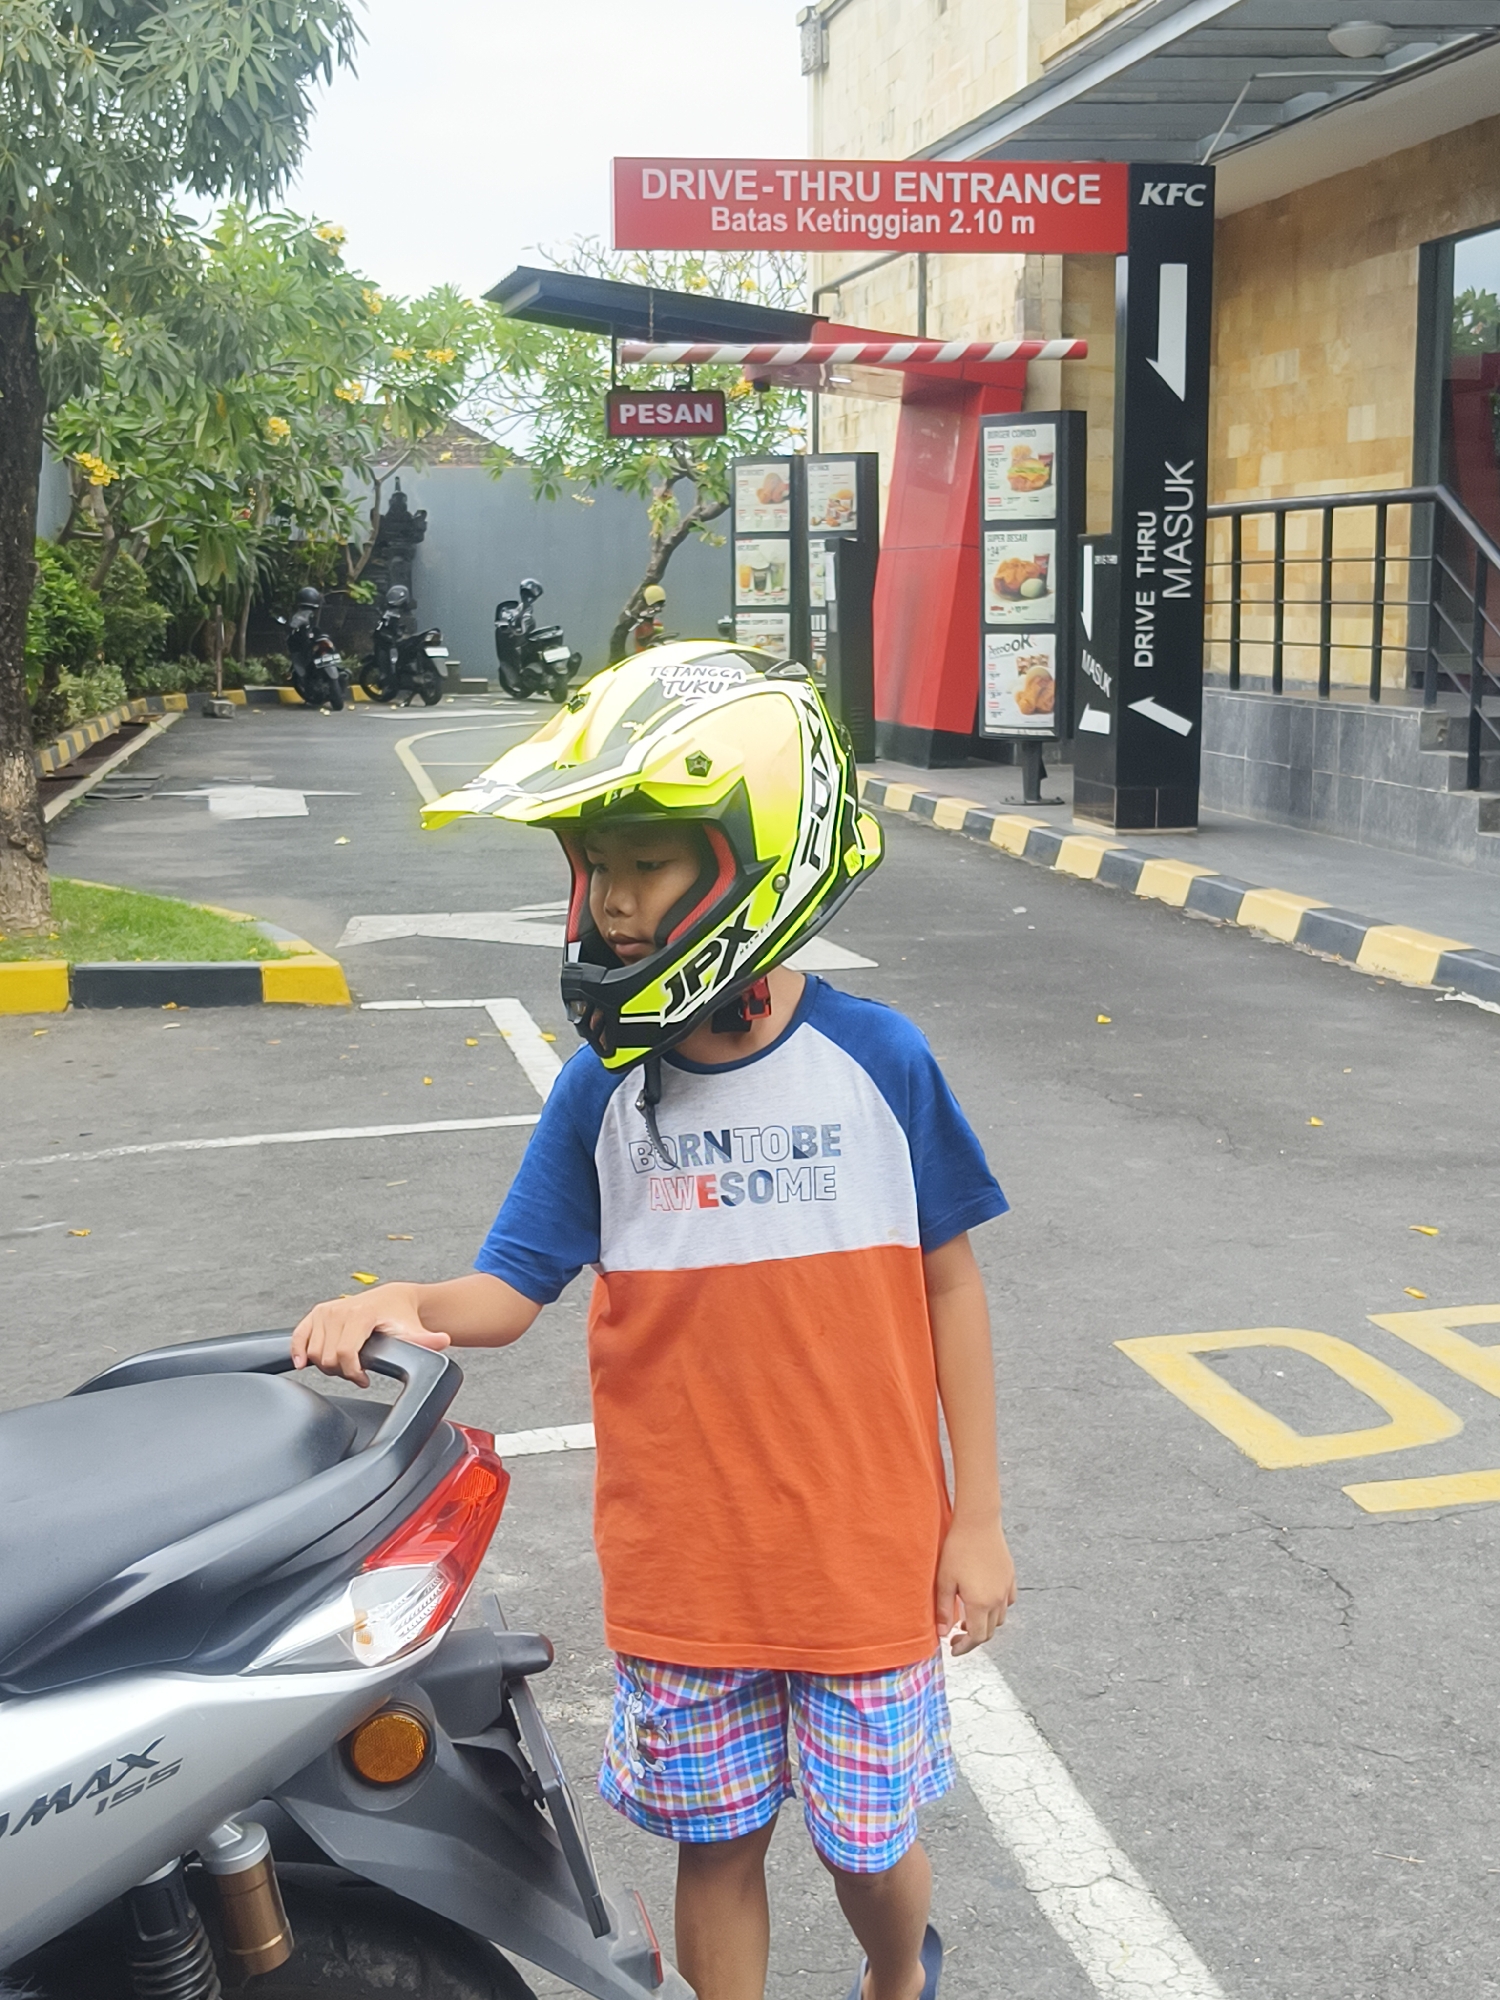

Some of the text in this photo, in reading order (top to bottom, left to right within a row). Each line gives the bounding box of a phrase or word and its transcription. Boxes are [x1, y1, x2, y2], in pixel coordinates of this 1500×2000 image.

[641, 168, 1102, 205] DRIVE-THRU ENTRANCE
[1138, 182, 1207, 207] KFC
[711, 206, 1035, 240] Batas Ketinggian 2.10 m
[620, 403, 714, 424] PESAN
[1161, 459, 1194, 600] MASUK
[1133, 511, 1157, 668] DRIVE THRU
[666, 679, 724, 695] TUKU
[664, 903, 757, 1018] JPX
[650, 1166, 836, 1211] AWESOME
[0, 1734, 166, 1839] MAX
[94, 1757, 184, 1817] 155
